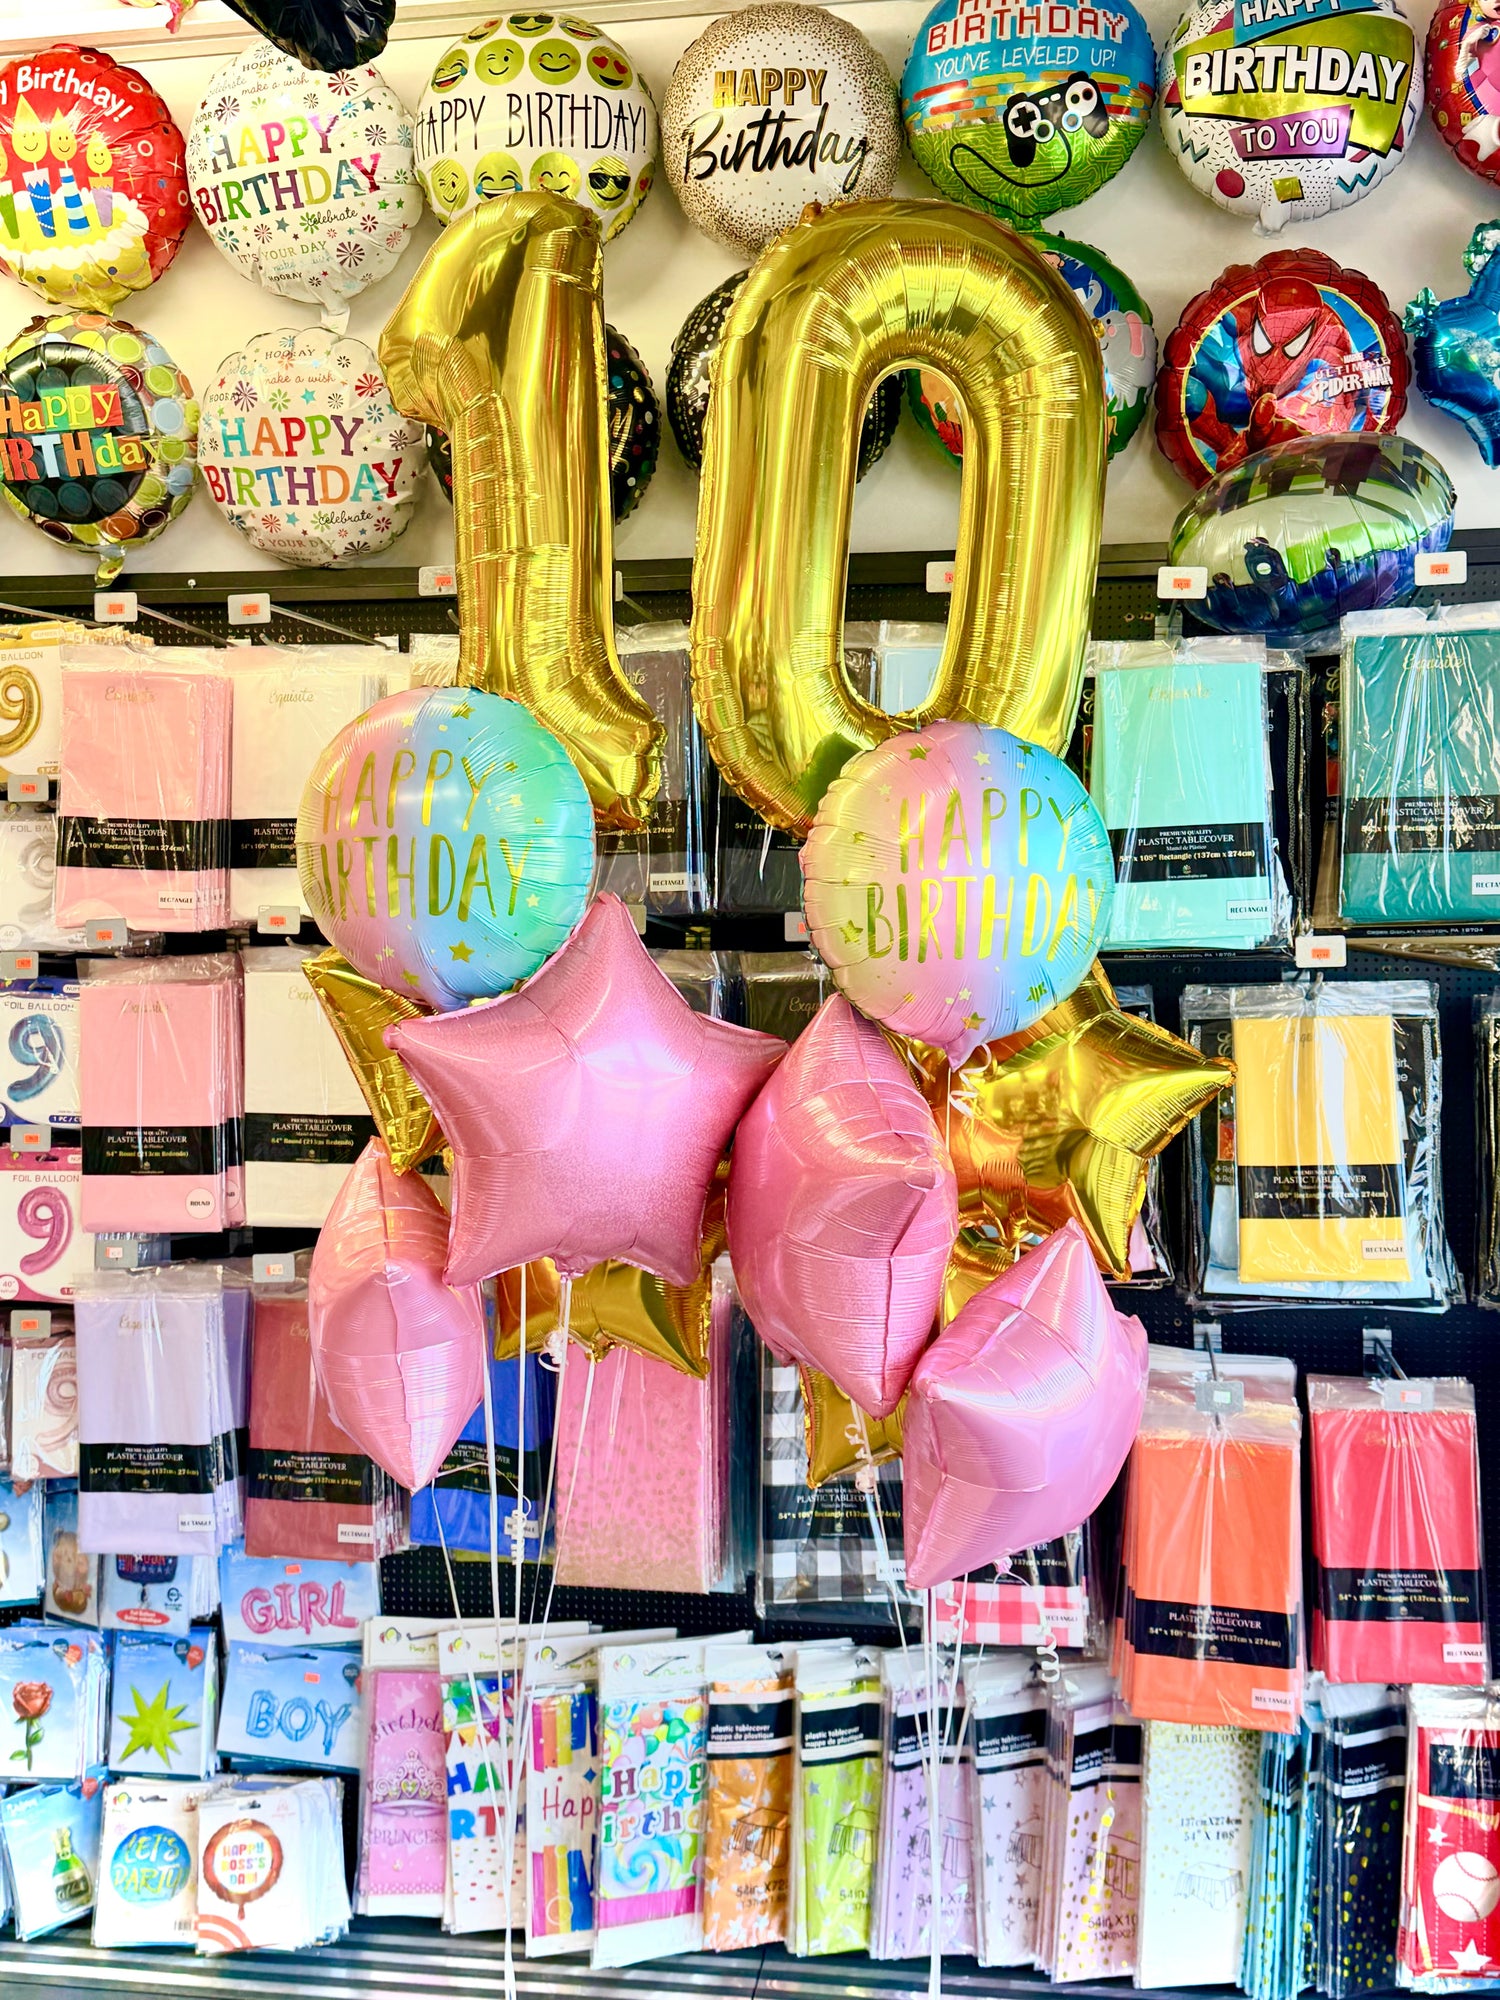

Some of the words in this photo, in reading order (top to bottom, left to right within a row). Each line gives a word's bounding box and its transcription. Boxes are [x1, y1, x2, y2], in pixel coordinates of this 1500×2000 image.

[927, 4, 1129, 54] BIRTHDAY
[242, 55, 288, 72] HOORAY
[935, 50, 991, 78] YOU'VE
[1002, 45, 1080, 67] LEVELED
[1090, 48, 1117, 67] UP!
[1185, 45, 1408, 103] BIRTHDAY
[241, 81, 269, 96] make
[284, 71, 309, 87] wish
[714, 67, 828, 108] HAPPY
[16, 65, 134, 123] Birthday!
[505, 93, 647, 152] BIRTHDAY!
[1240, 127, 1276, 152] TO
[1283, 117, 1341, 147] YOU
[207, 114, 340, 174] HAPPY
[682, 102, 874, 194] Birthday
[196, 153, 382, 227] BIRTHDAY
[307, 208, 358, 227] celebrate
[238, 253, 260, 264] IT'S
[262, 247, 297, 261] YOUR
[300, 240, 327, 255] DAY
[265, 348, 316, 361] HOORAY
[1315, 357, 1391, 380] ULTIMATE
[1310, 366, 1393, 406] SPIDER-MAN
[221, 414, 365, 459] HAPPY
[203, 457, 404, 508] BIRTHDAY
[318, 508, 374, 526] celebrate
[1, 651, 44, 663] BALLOON
[320, 749, 498, 835] HAPPY
[88, 827, 119, 836] PLASTIC
[254, 827, 280, 837] PLASTIC
[899, 787, 1076, 875] HAPPY
[1138, 836, 1174, 846] PLASTIC
[1176, 834, 1235, 845] TABLECOVER
[1159, 852, 1192, 861] Rectangle
[652, 878, 686, 887] RECTANGLE
[1230, 905, 1268, 914] RECTANGLE
[866, 873, 1107, 964] BIRTHDAY
[272, 1122, 301, 1132] PLASTIC
[303, 1123, 353, 1132] TABLECOVER
[107, 1135, 137, 1144] PLASTIC
[12, 1174, 32, 1183] FOIL
[35, 1174, 80, 1184] BALLOON
[18, 1186, 73, 1276] 9
[1365, 1246, 1403, 1254] RECTANGLE
[107, 1452, 134, 1461] PLASTIC
[273, 1459, 299, 1469] PLASTIC
[301, 1461, 347, 1471] TABLECOVER
[796, 1495, 828, 1504] PLASTIC
[1357, 1578, 1392, 1588] PLASTIC
[241, 1580, 359, 1635] GIRL
[1169, 1612, 1202, 1623] PLASTIC
[246, 1690, 353, 1756] BOY
[711, 1725, 733, 1734] plastic
[735, 1724, 770, 1733] tablecover
[711, 1733, 732, 1742] nappe
[743, 1731, 774, 1741] plastique
[805, 1730, 827, 1740] plastic
[828, 1726, 860, 1739] tablecover
[805, 1738, 826, 1748] nappe
[828, 1737, 836, 1745] de
[837, 1733, 864, 1745] plastique
[898, 1735, 917, 1746] plastic
[979, 1739, 1001, 1749] plastic
[1001, 1733, 1033, 1745] tablecover
[1175, 1734, 1252, 1744] TABLECOVER
[979, 1746, 1000, 1755] nappe
[1010, 1741, 1037, 1751] plastique
[1184, 1829, 1202, 1841] 54"
[1204, 1830, 1211, 1840] X
[1214, 1828, 1240, 1841] 108"
[124, 1833, 180, 1865] LET'S
[223, 1841, 265, 1858] HAPPY
[221, 1856, 266, 1872] BOSS'S
